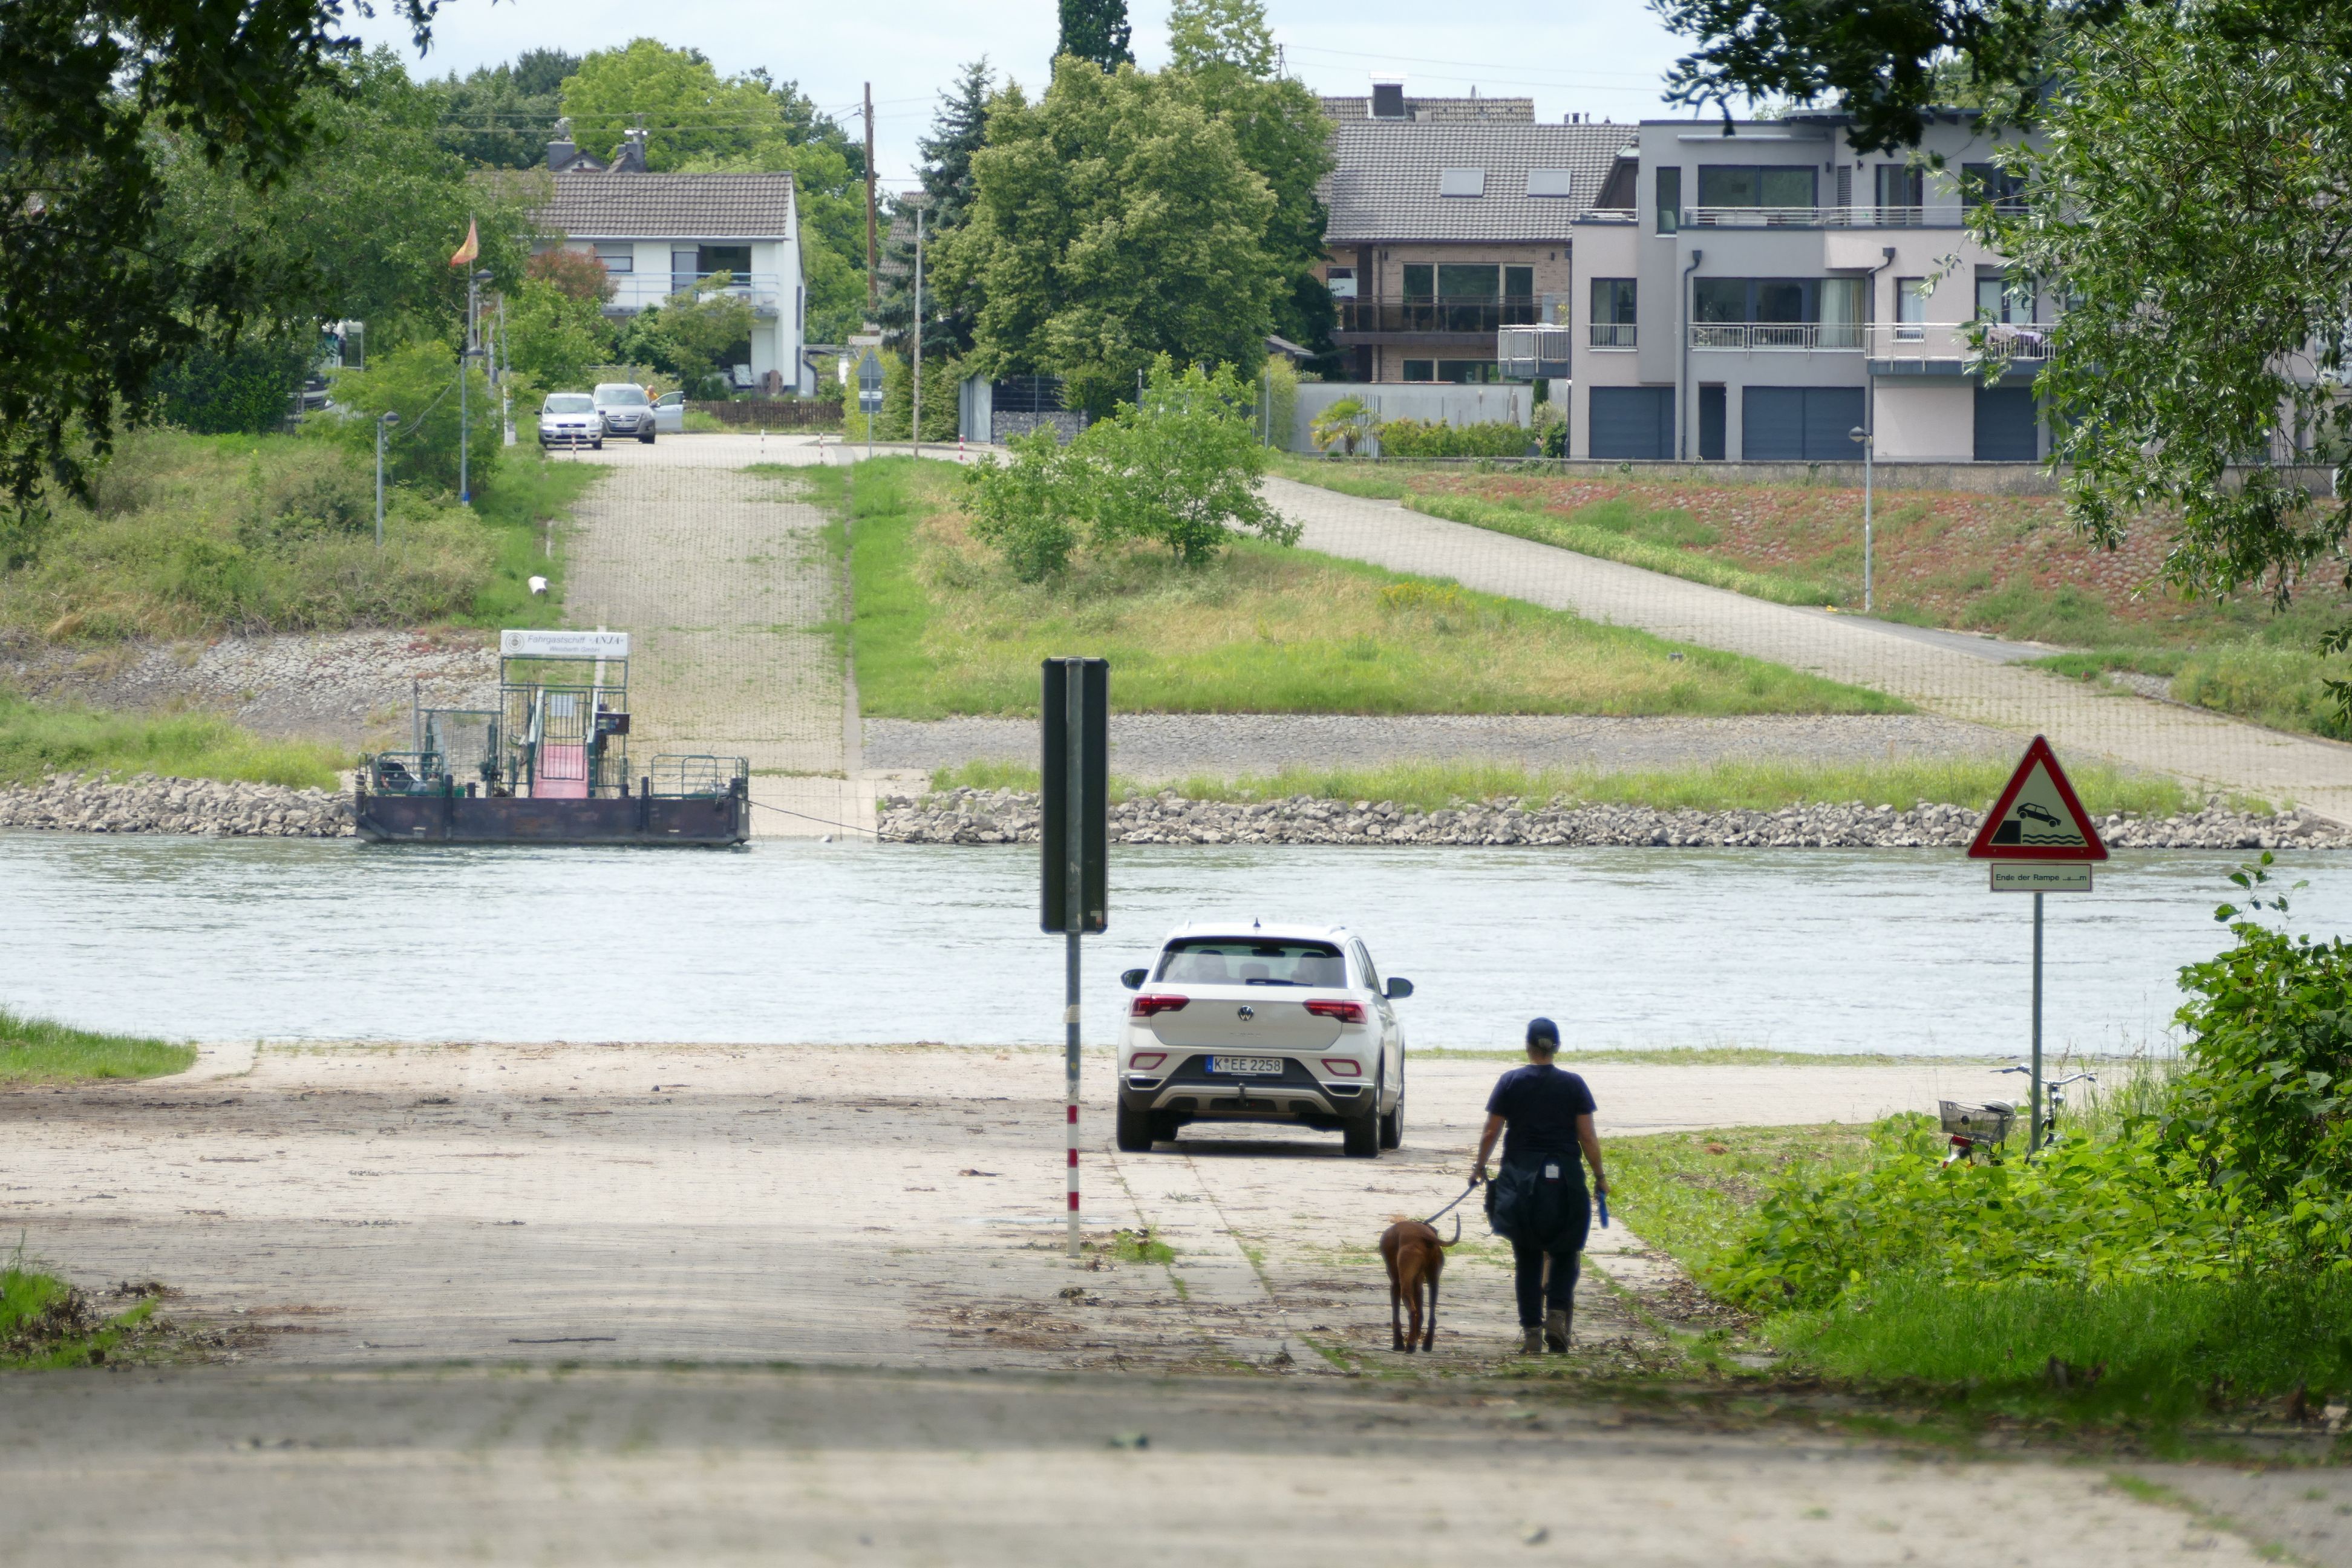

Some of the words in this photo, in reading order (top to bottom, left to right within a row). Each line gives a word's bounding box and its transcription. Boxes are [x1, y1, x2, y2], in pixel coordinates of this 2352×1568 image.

[527, 635, 586, 644] Fahrgastschiff
[1231, 1059, 1247, 1071] EE
[1250, 1059, 1281, 1071] 2258
